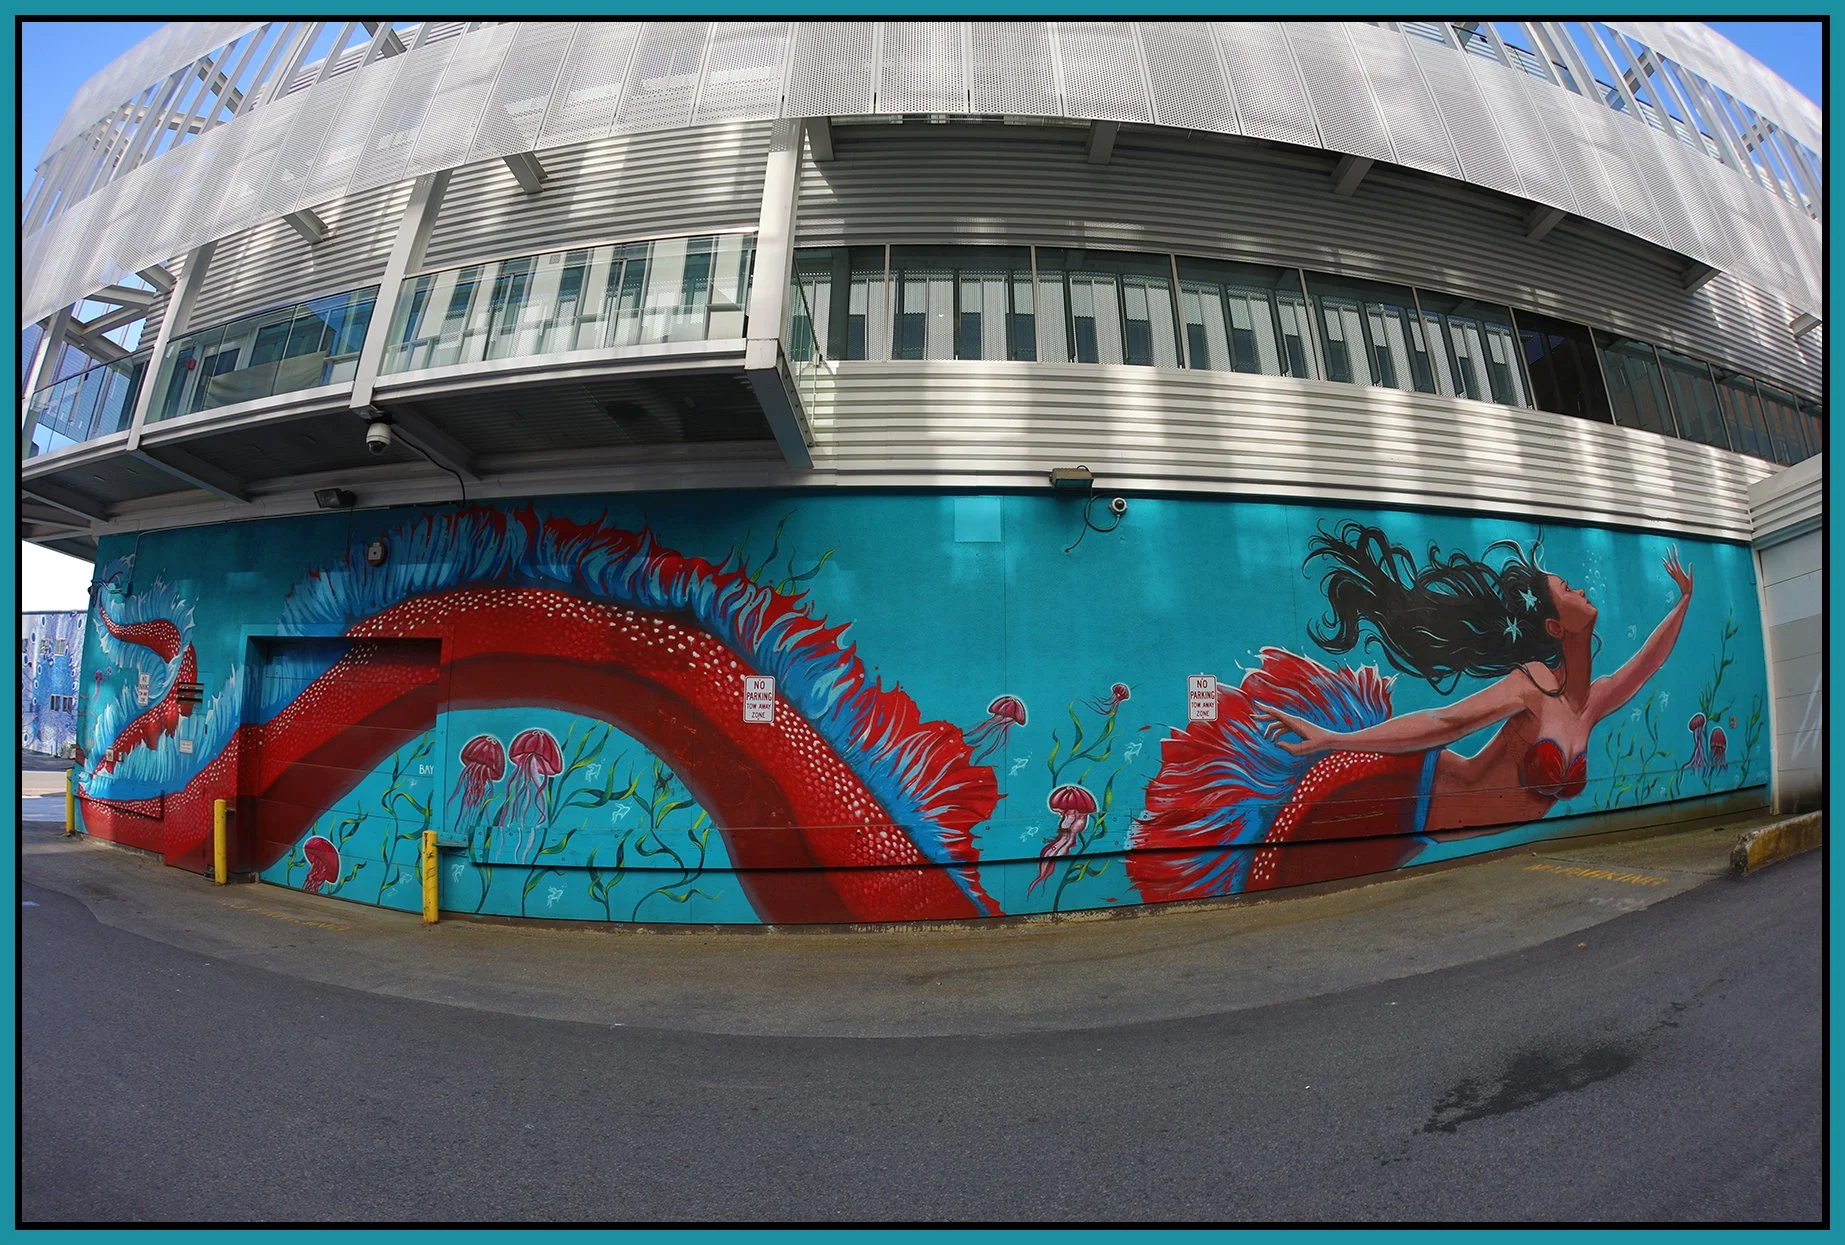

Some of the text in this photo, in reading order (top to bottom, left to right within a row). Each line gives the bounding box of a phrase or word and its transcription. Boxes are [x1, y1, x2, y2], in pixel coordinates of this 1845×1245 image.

[754, 681, 765, 689] NO
[1197, 680, 1208, 688] NO
[747, 692, 773, 701] PARKING
[1191, 691, 1215, 699] PARKING
[419, 764, 434, 774] BAY
